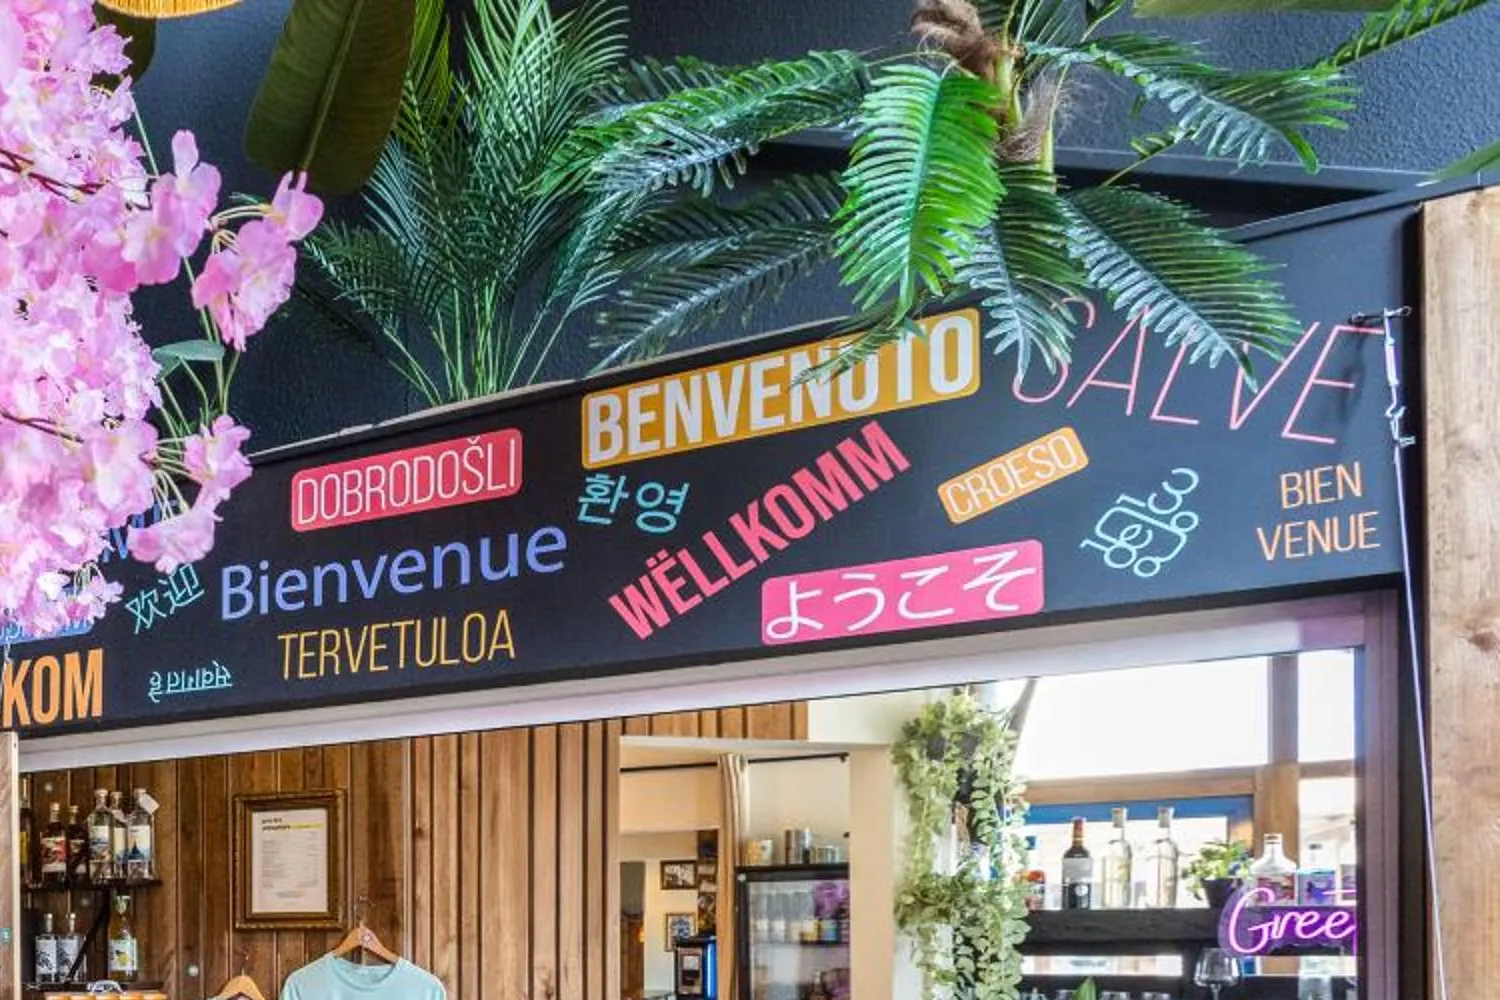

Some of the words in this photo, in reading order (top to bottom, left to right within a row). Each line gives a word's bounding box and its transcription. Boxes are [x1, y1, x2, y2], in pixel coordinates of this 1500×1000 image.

[587, 316, 975, 465] BENVENUTO
[299, 433, 517, 524] DOBRODOŠLI
[577, 473, 690, 534] 환영
[945, 431, 1077, 517] CROESO
[1280, 462, 1363, 510] BIEN
[220, 525, 568, 621] Bienvenue
[608, 420, 912, 641] WËLLKOMM
[1256, 511, 1381, 561] VENUE
[125, 563, 204, 635] 欢迎
[766, 549, 1037, 639] ようこそ
[277, 609, 517, 681] TERVETULOA
